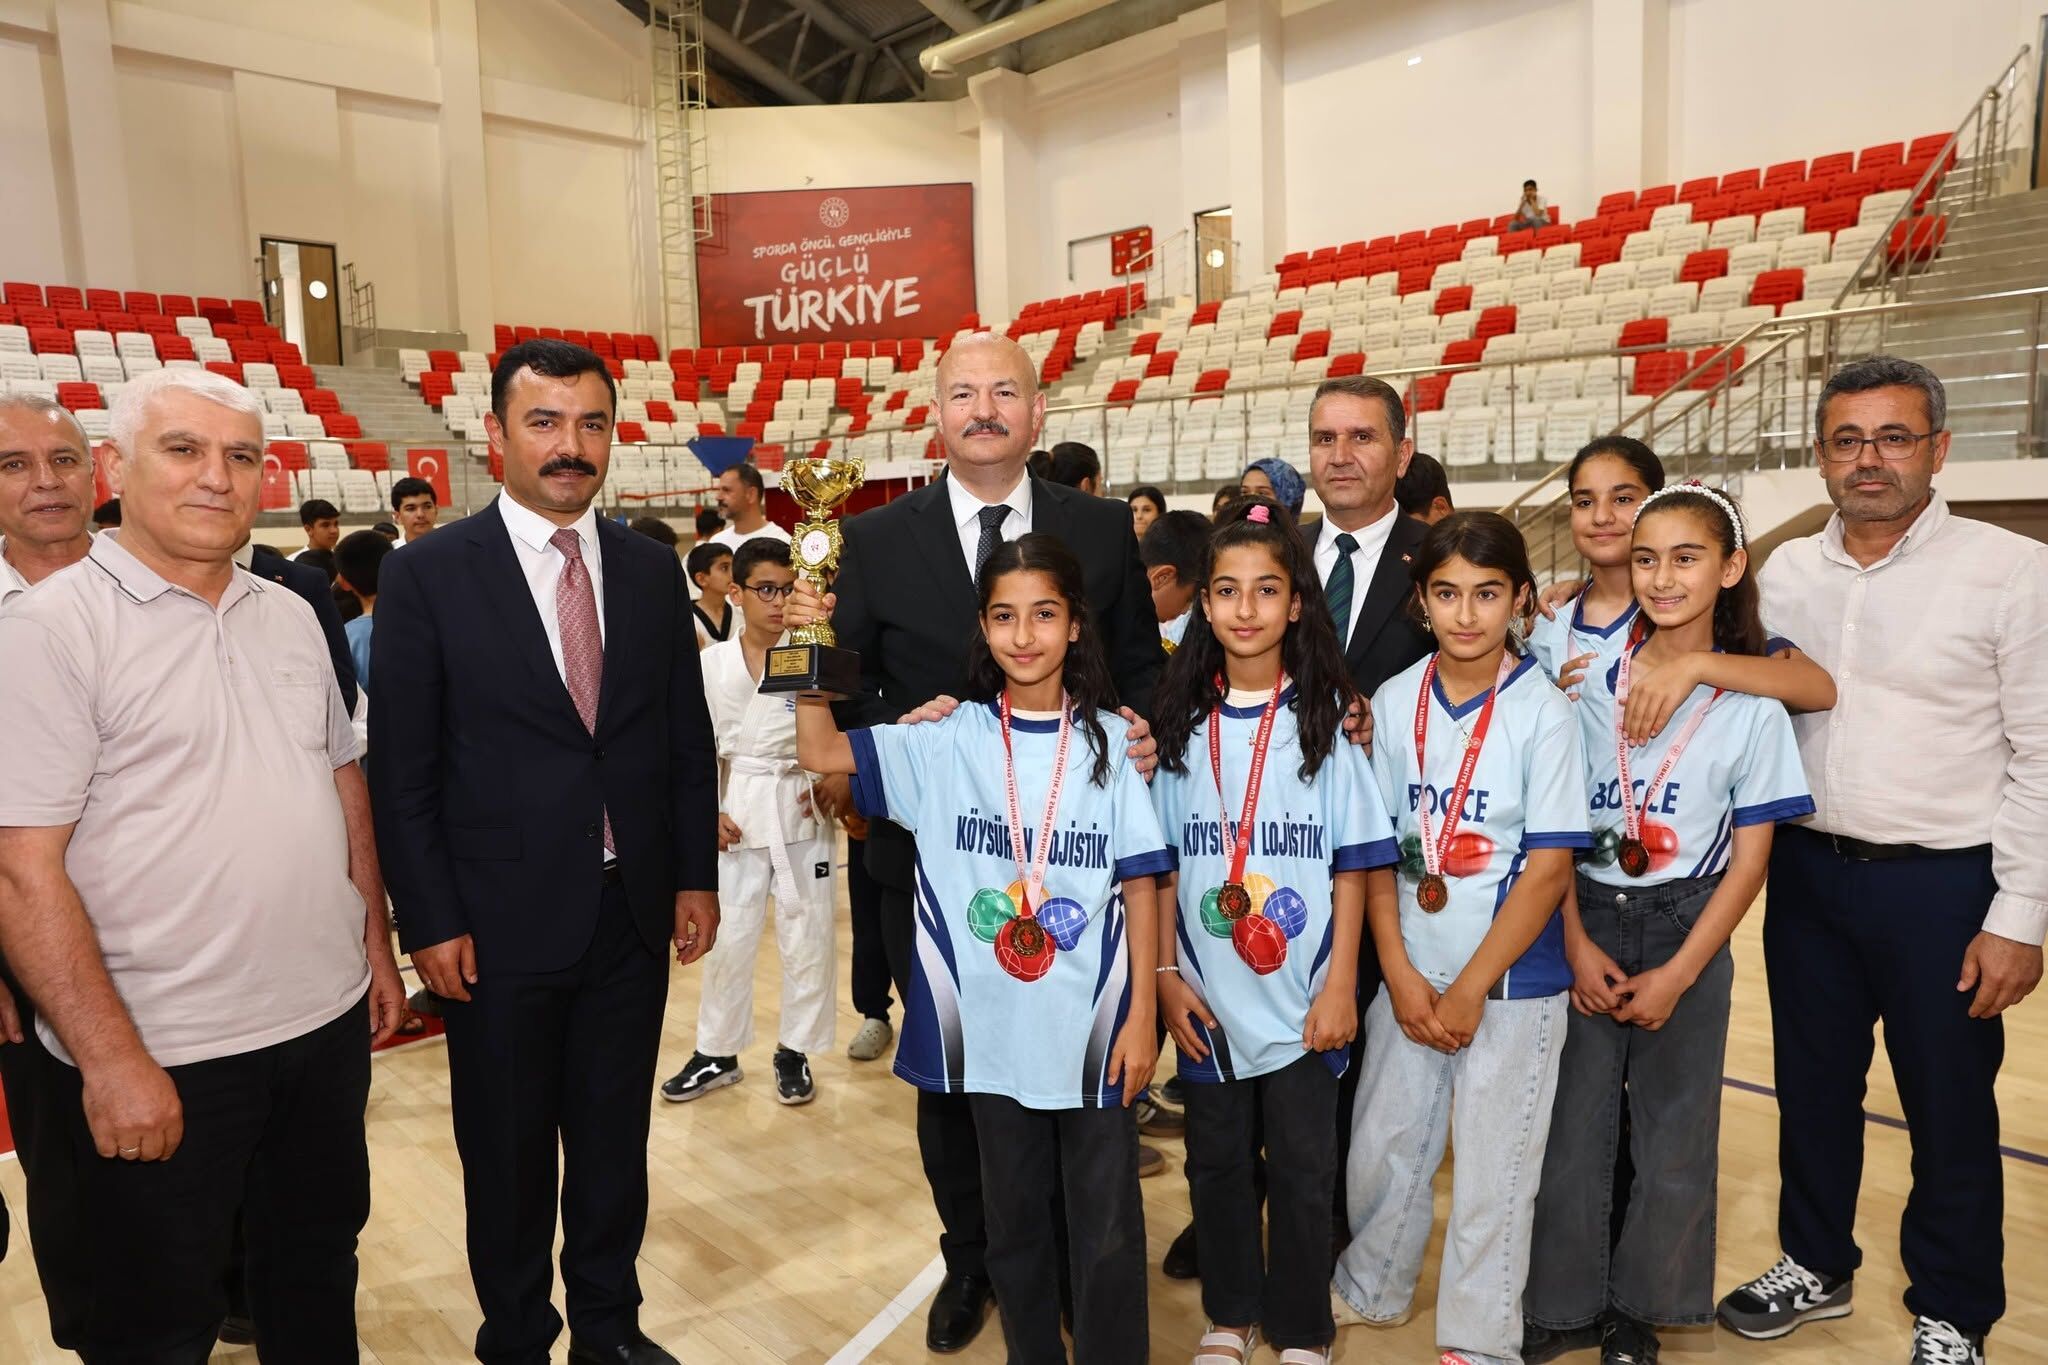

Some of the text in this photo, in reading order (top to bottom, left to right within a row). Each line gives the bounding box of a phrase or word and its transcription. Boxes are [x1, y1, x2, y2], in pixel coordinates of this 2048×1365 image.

[753, 242, 797, 258] SPORDA
[838, 227, 912, 246] GENÇLİĞİYLE
[781, 247, 869, 284] GÜÇLÜ
[743, 276, 921, 339] TÜRKİYE
[1242, 800, 1253, 830] TÜRKİYE
[1248, 750, 1262, 799] CUMHURİYETİ
[1265, 708, 1272, 718] VE
[1461, 752, 1475, 783] TÜRKİYE
[1445, 784, 1465, 833] CUMHURİYETİ
[956, 808, 1109, 869] KÖYSÜRN OJİSTİK
[1261, 811, 1324, 860] LOJİSTİK
